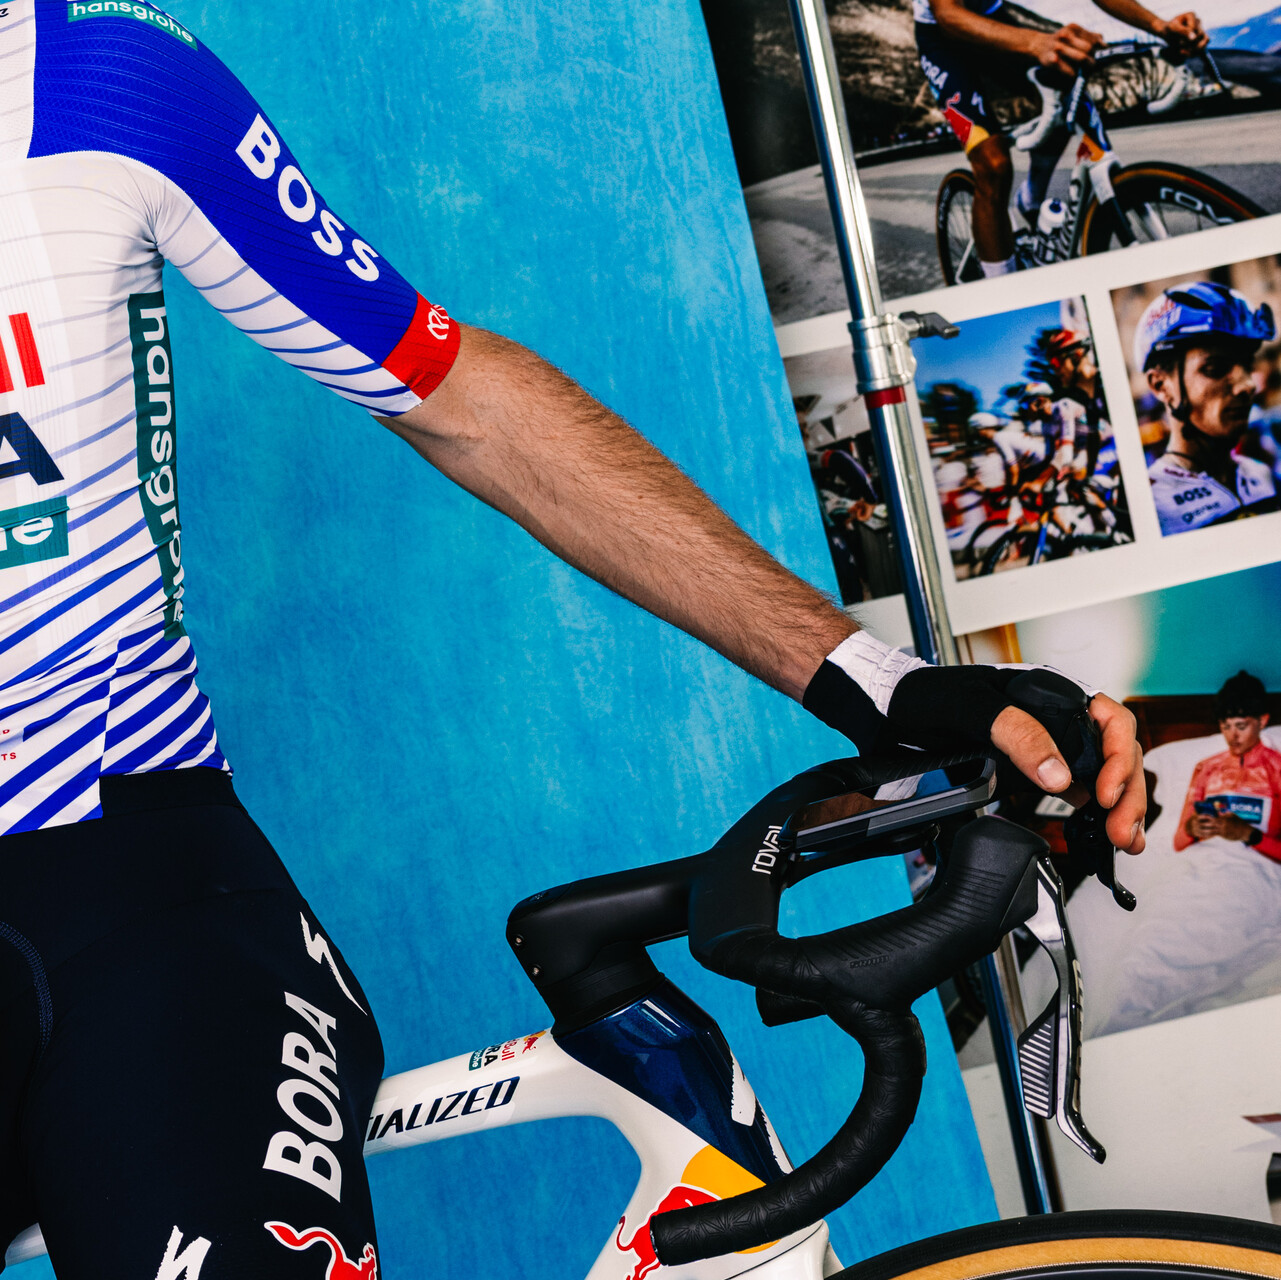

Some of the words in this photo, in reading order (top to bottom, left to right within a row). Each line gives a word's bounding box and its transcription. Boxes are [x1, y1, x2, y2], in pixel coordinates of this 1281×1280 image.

[72, 0, 194, 44] hansgrohe
[234, 113, 380, 282] BOSS
[1172, 486, 1213, 507] BOSS
[262, 991, 344, 1203] BORA
[367, 1075, 521, 1142] IALIZED
